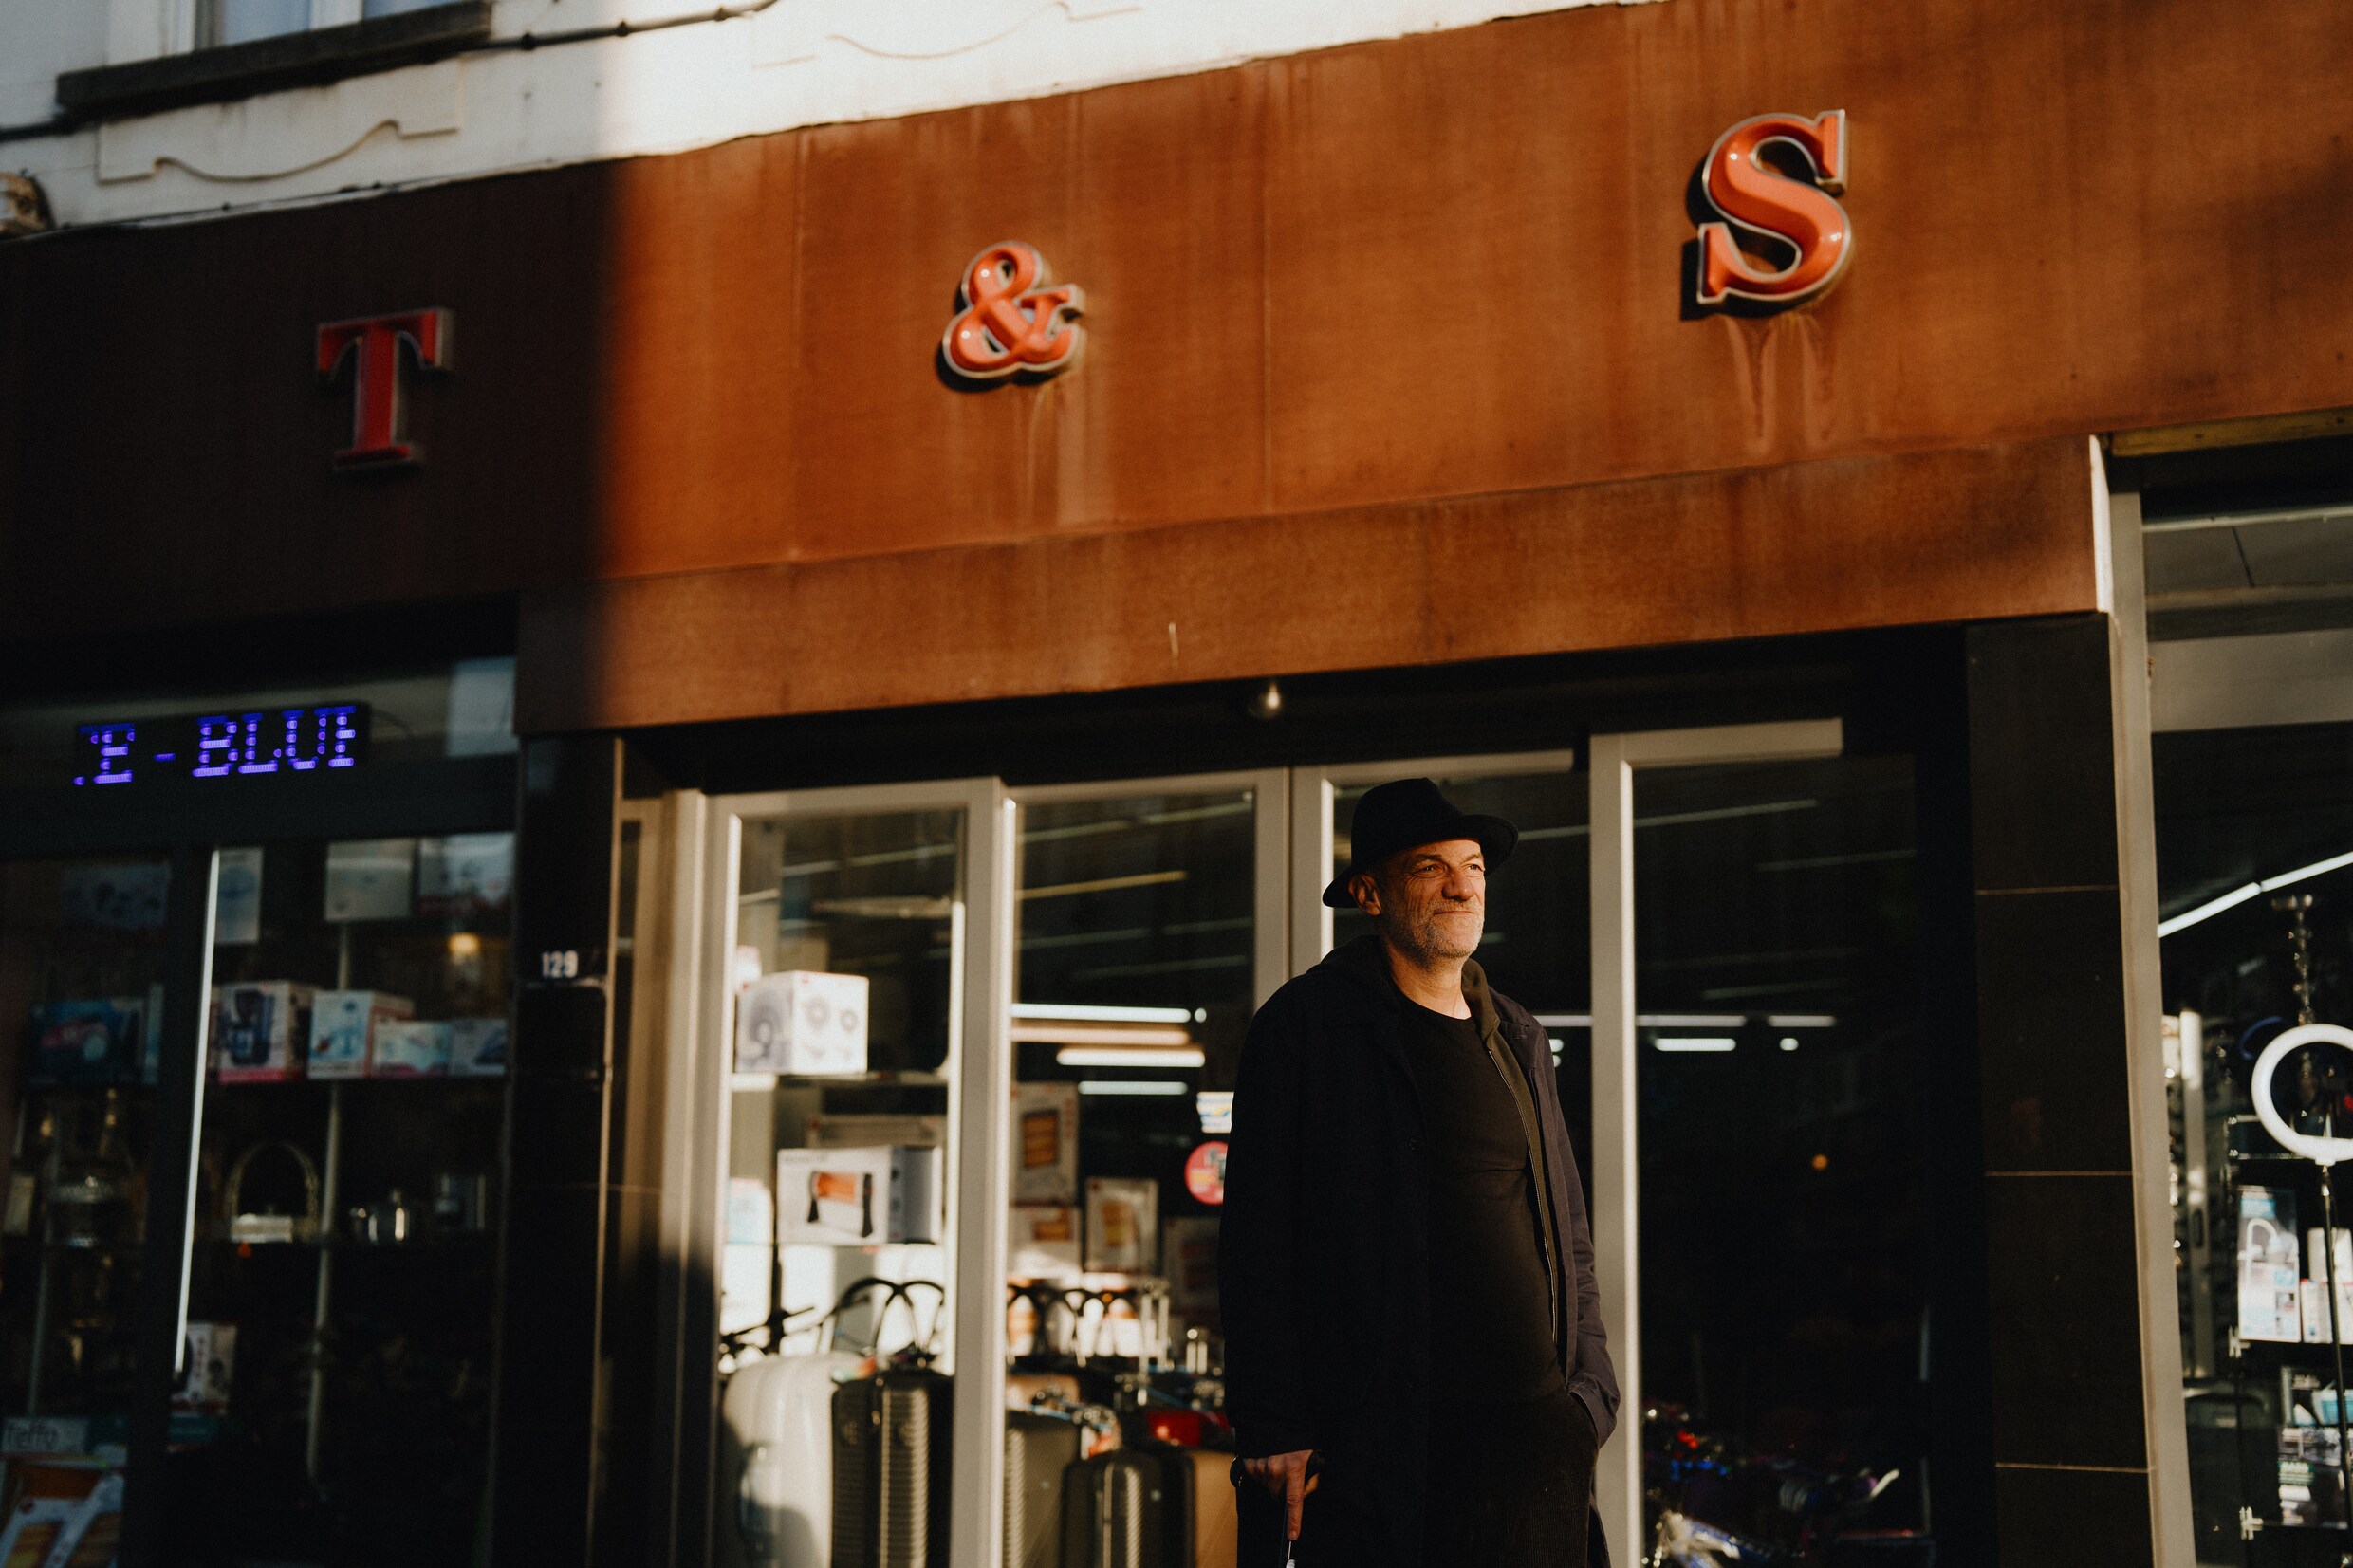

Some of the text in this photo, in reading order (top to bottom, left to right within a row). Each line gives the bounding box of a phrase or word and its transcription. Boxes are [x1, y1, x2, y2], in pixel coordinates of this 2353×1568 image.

[316, 108, 1853, 470] T & S
[541, 950, 579, 979] 129
